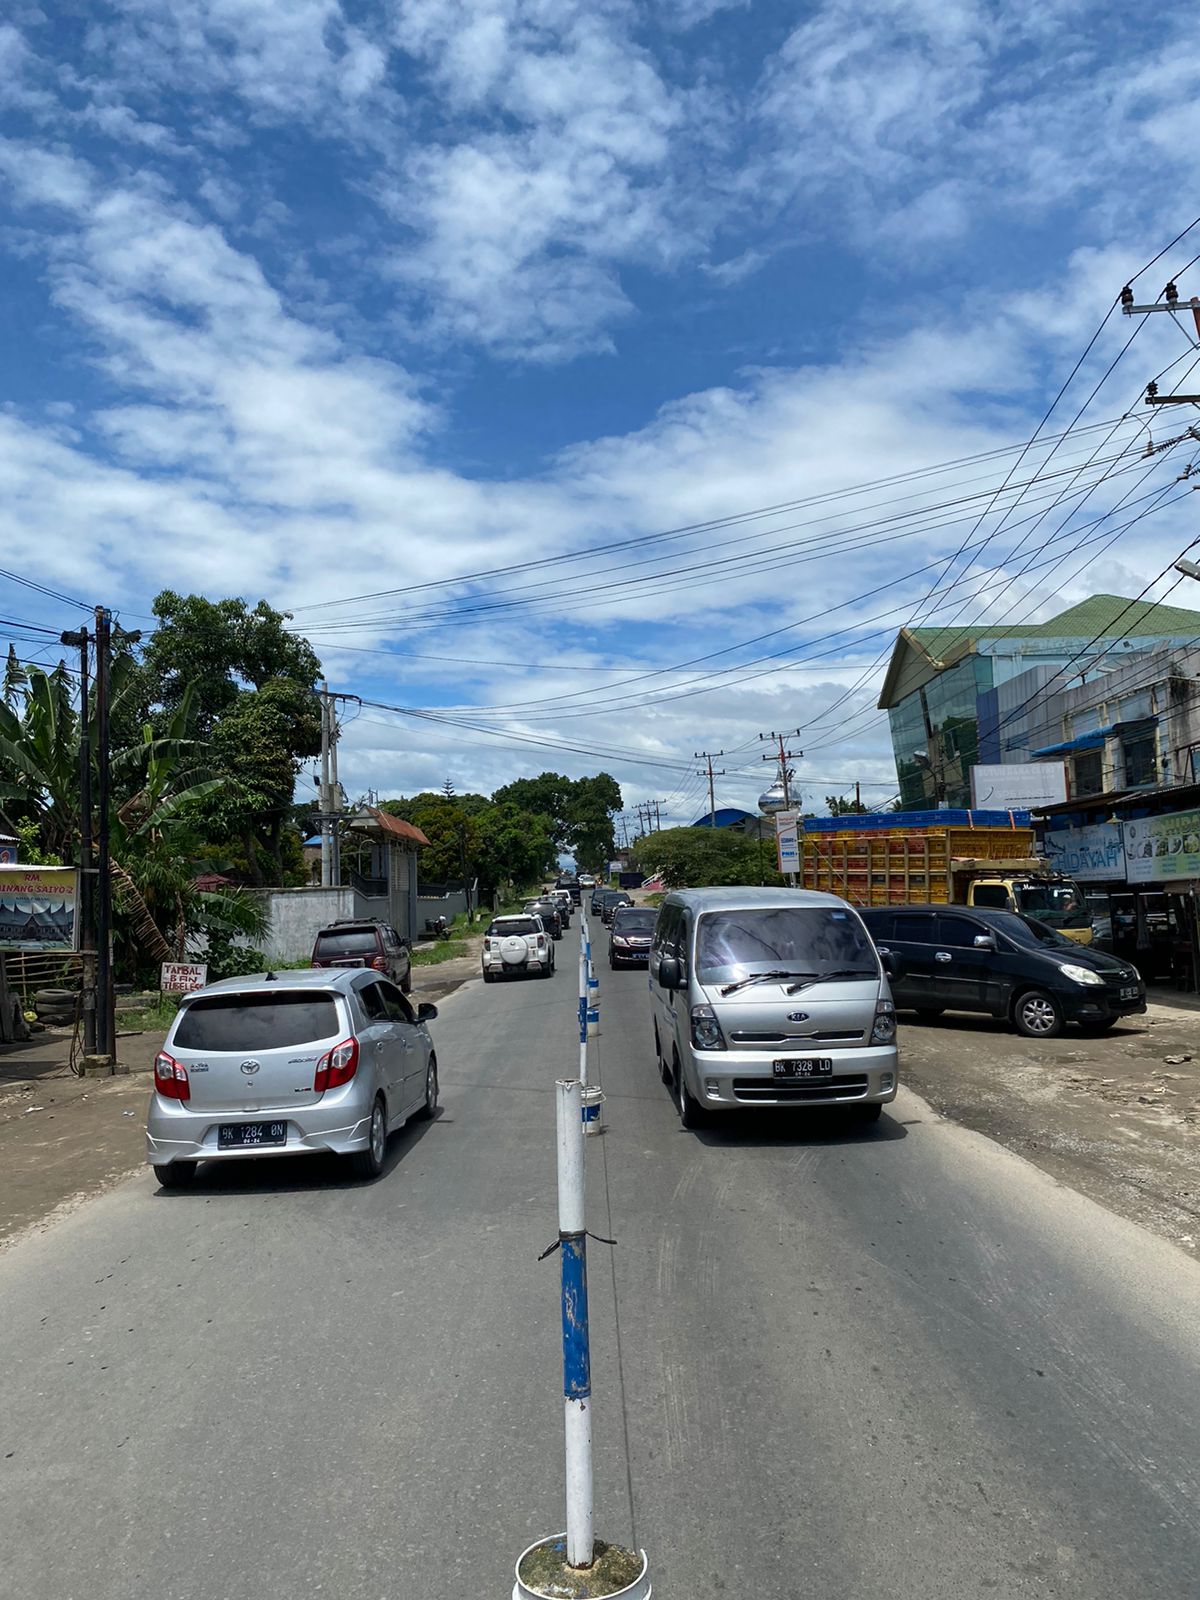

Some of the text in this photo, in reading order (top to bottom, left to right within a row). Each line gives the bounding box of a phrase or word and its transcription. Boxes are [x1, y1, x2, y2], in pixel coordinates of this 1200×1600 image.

[1057, 847, 1118, 870] HIDAYAH
[164, 964, 201, 975] TAMBAL
[170, 975, 197, 983] BAN
[775, 1061, 786, 1072] BK
[791, 1060, 813, 1072] 7328
[241, 1125, 263, 1138] 1284
